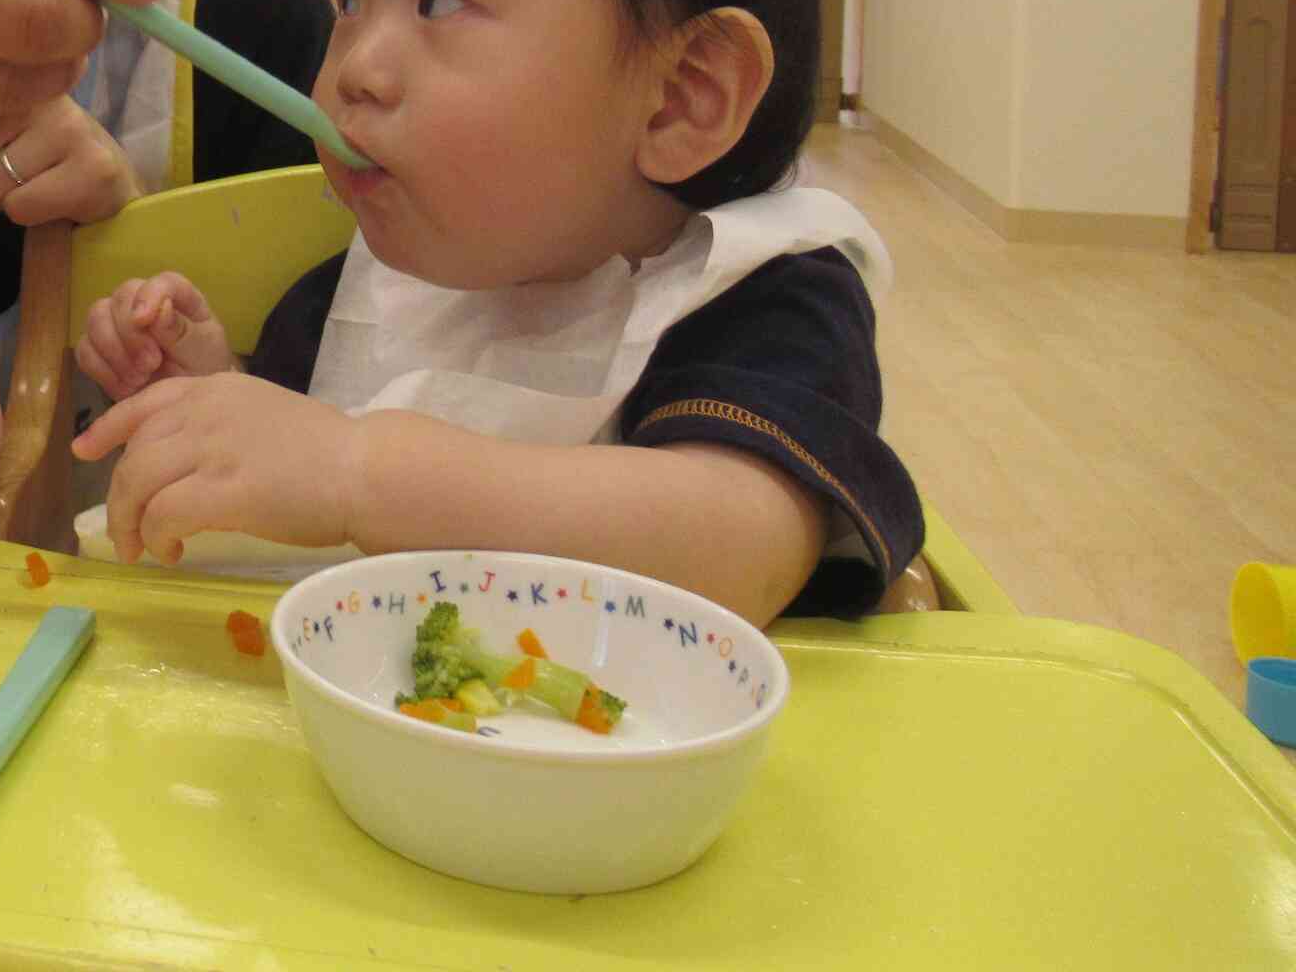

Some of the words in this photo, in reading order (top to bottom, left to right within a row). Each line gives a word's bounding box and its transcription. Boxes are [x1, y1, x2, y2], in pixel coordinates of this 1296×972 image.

[324, 615, 333, 641] F
[348, 591, 360, 613] G
[389, 593, 406, 614] H
[430, 570, 447, 592] I
[479, 571, 496, 592] J
[531, 582, 547, 604] K
[581, 579, 594, 601] L
[625, 595, 645, 618] M
[678, 622, 697, 647] N
[719, 637, 733, 658] O
